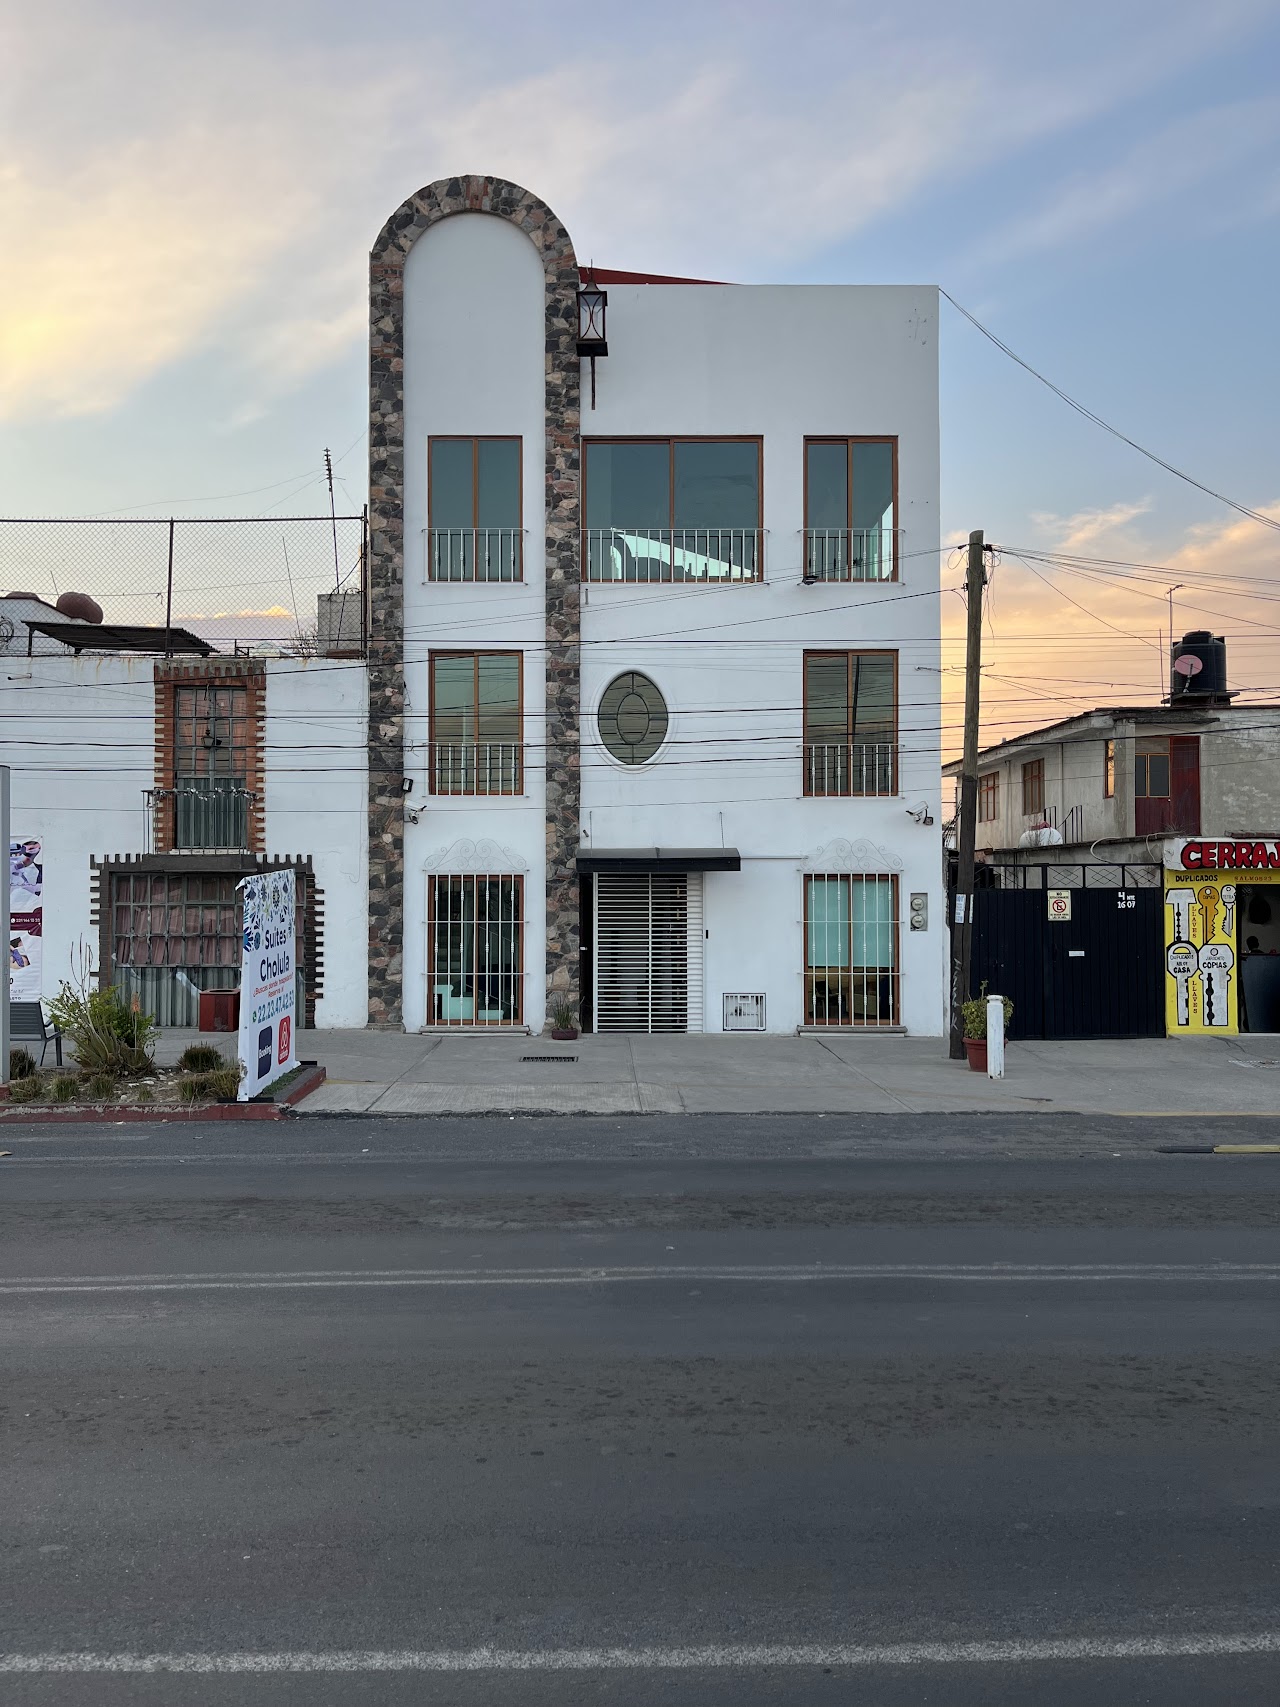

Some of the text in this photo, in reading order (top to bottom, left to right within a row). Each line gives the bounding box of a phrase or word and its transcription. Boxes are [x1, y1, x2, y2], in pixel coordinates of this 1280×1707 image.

[1175, 874, 1218, 882] DUPLICADOS
[1118, 891, 1125, 900] 4
[265, 926, 287, 950] Suites
[260, 950, 290, 981] Cholula
[1202, 961, 1228, 969] COPIAS
[1173, 966, 1191, 974] CASA
[258, 1045, 272, 1059] Booking
